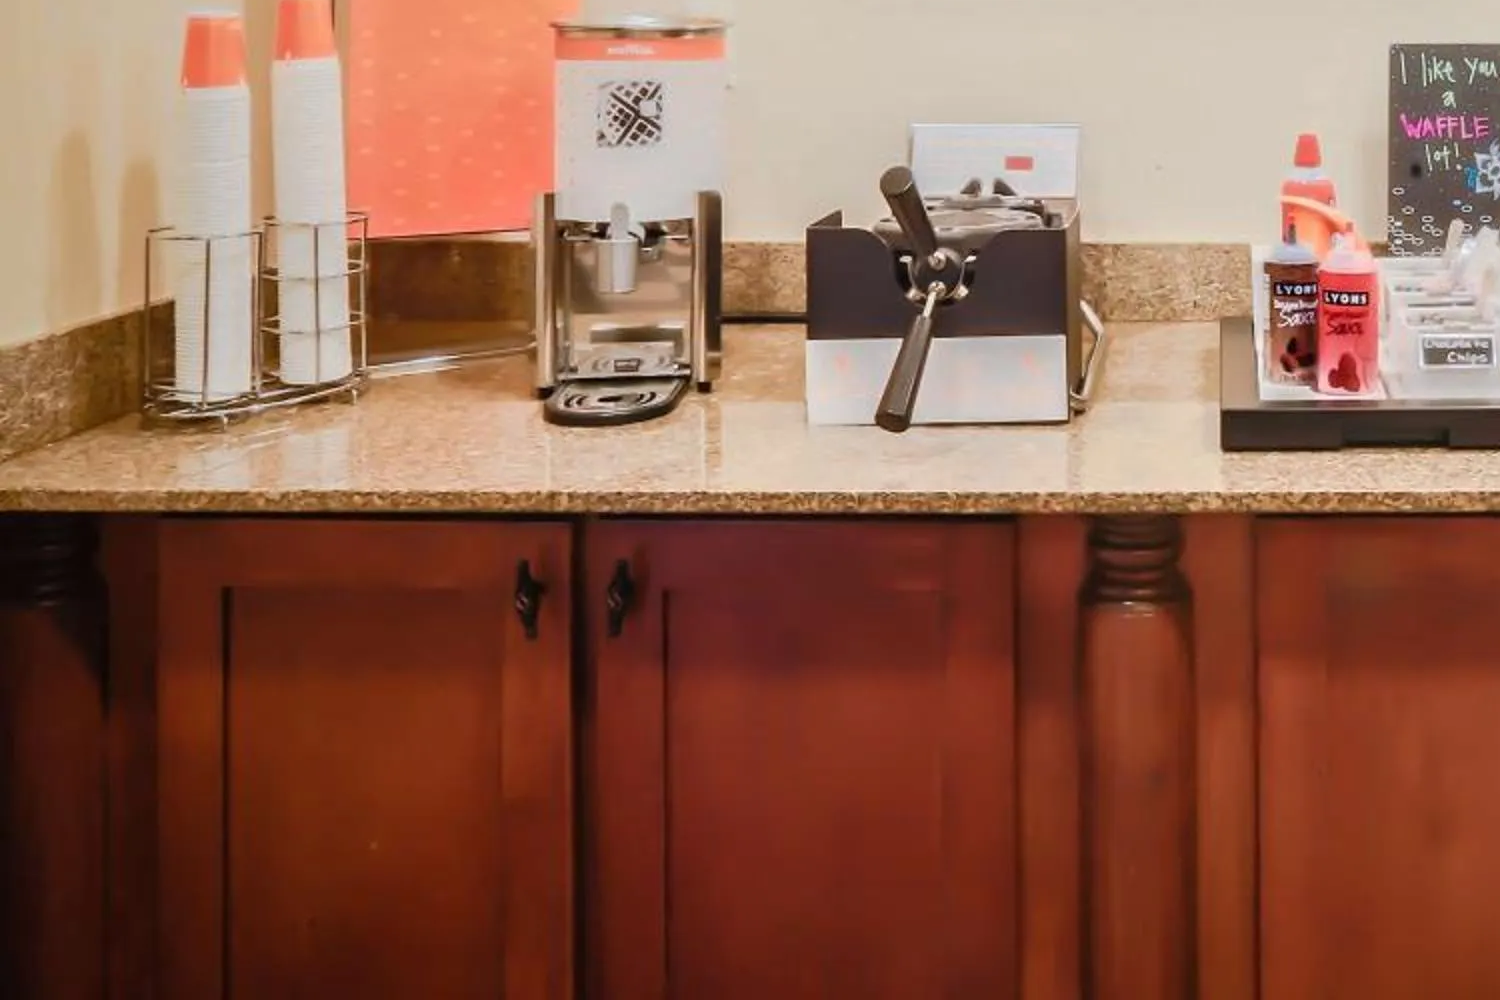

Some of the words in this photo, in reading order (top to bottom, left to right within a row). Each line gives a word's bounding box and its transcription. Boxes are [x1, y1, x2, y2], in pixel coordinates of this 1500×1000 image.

[1399, 51, 1408, 85] I
[1421, 52, 1457, 87] like
[1441, 90, 1457, 108] a
[1399, 113, 1490, 140] WAFFLE
[1424, 143, 1463, 172] lot!
[1324, 292, 1367, 305] LYONS
